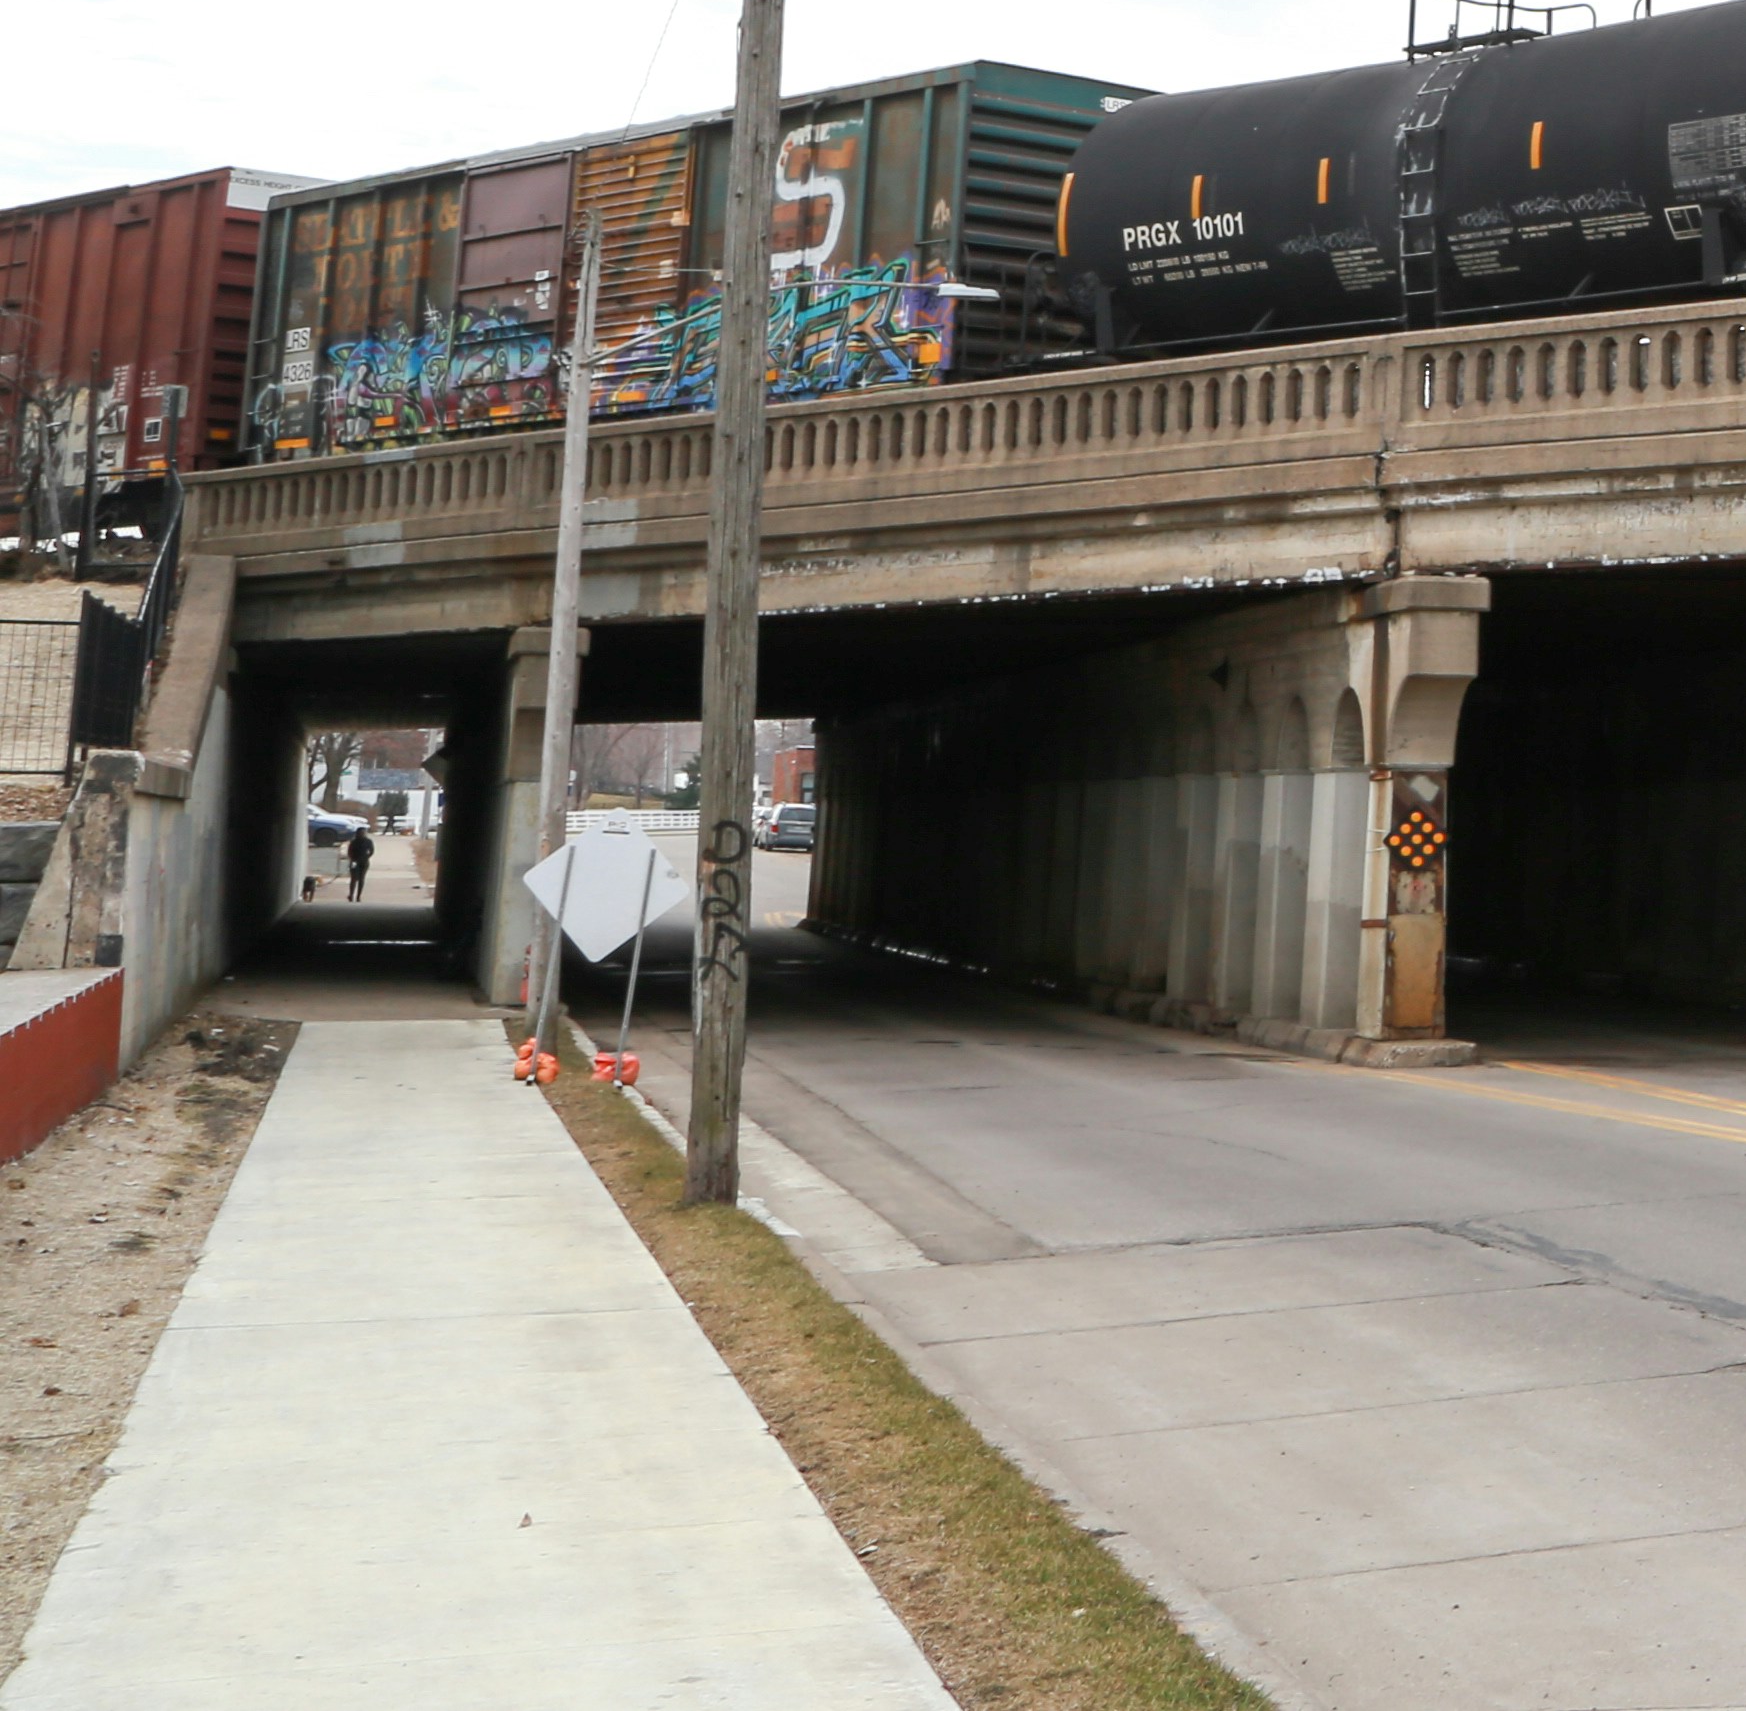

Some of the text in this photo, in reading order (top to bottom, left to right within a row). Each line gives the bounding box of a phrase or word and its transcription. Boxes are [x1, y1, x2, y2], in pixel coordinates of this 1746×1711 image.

[1122, 220, 1182, 252] PRGX
[1192, 211, 1245, 241] 10101
[286, 330, 310, 350] LRS
[283, 362, 313, 384] 4326
